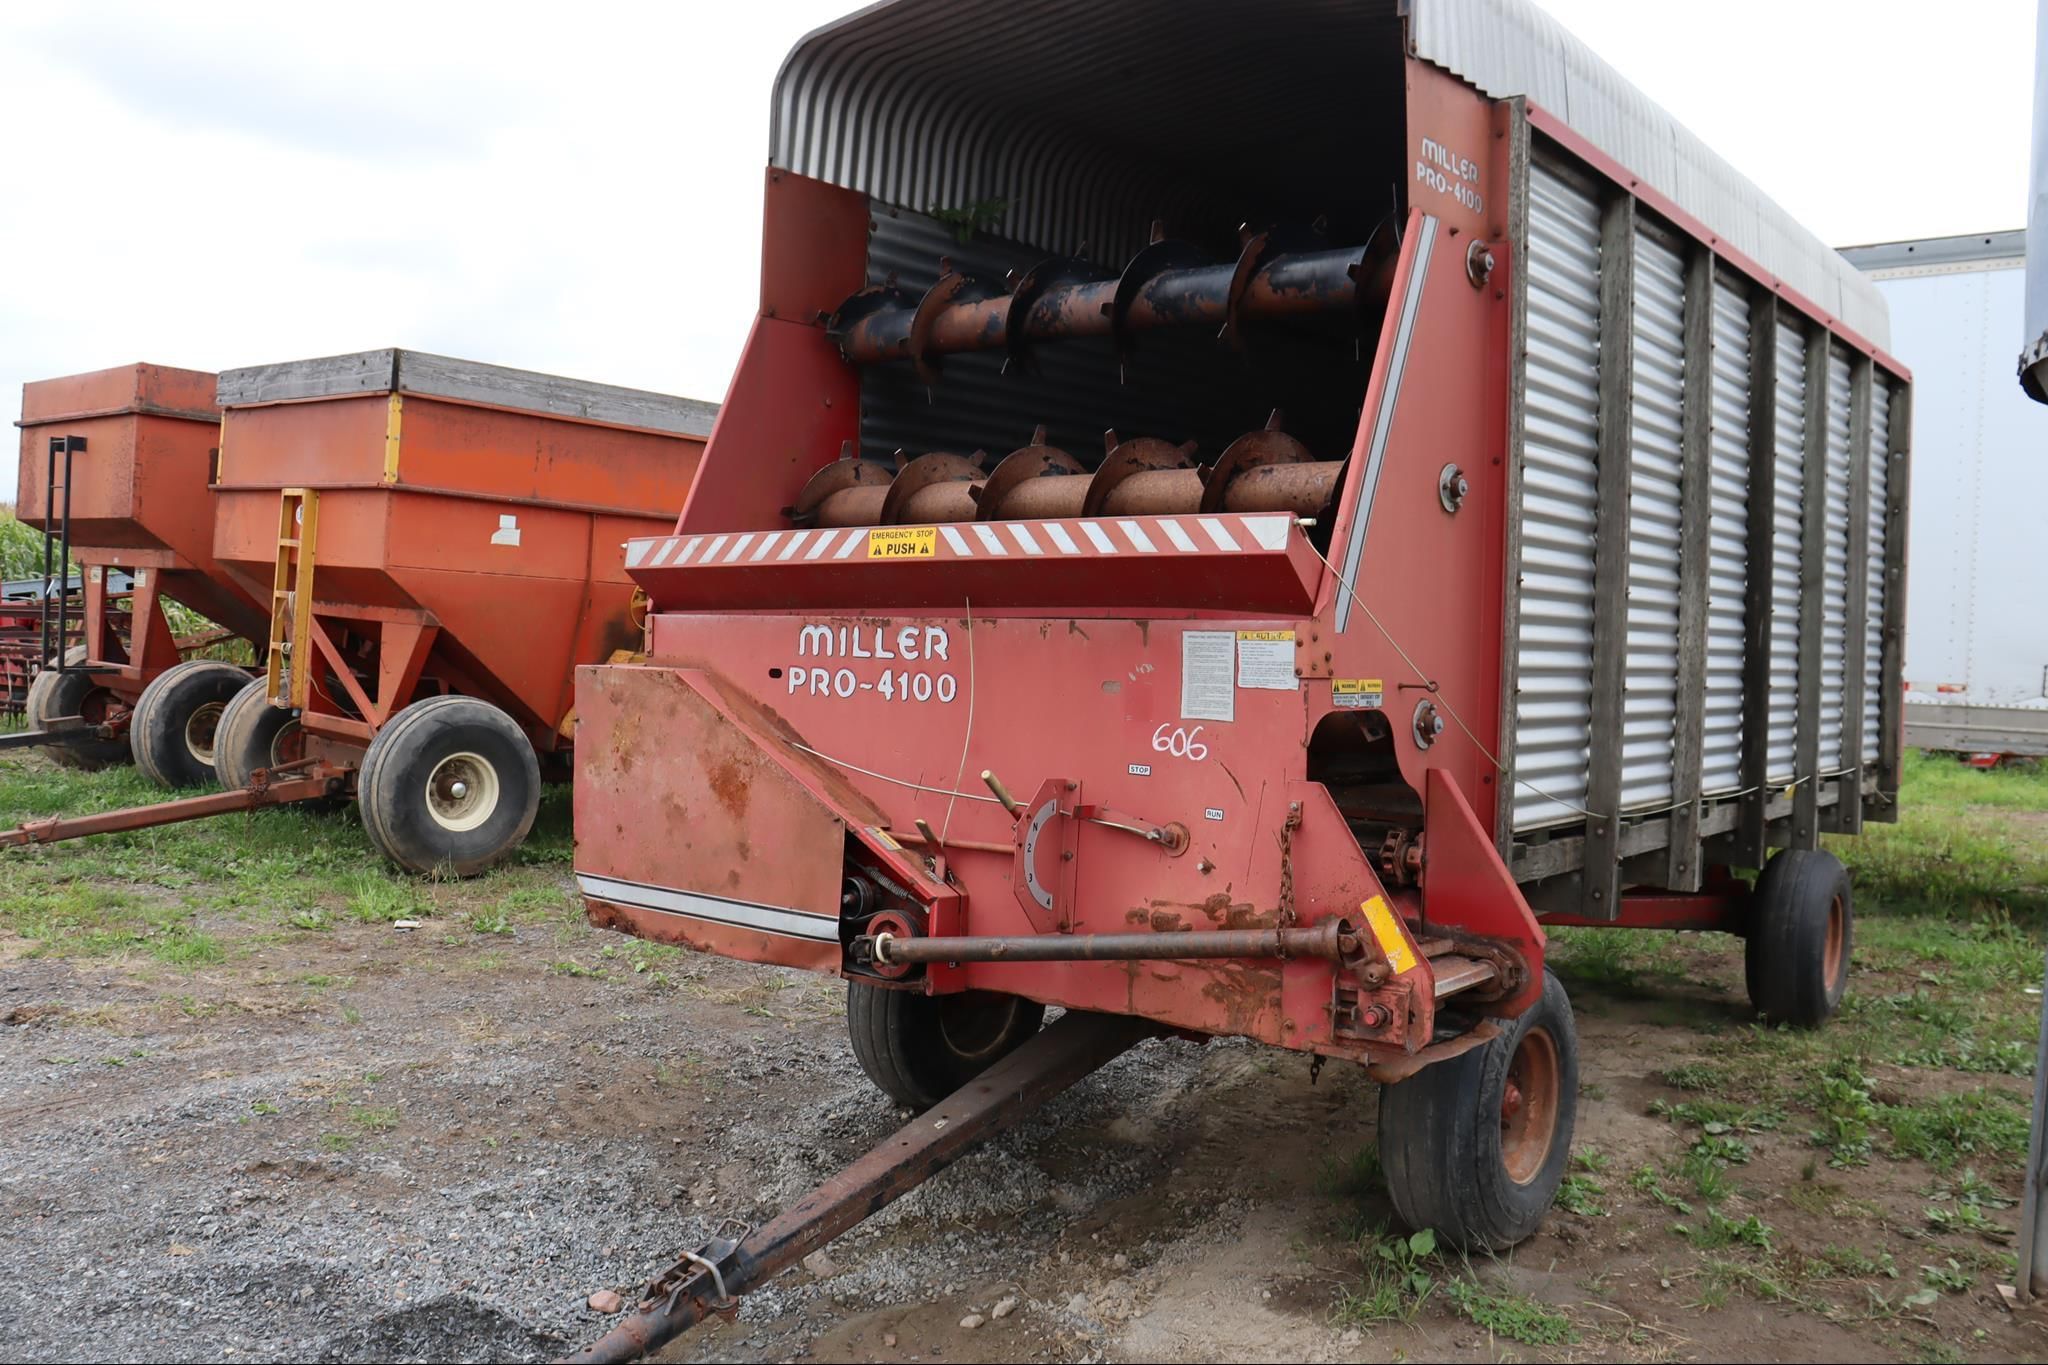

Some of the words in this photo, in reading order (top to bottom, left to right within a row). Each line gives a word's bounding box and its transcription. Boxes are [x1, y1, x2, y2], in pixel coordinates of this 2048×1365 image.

[1422, 138, 1478, 184] MILLER
[1417, 161, 1482, 213] PRO-4100
[872, 531, 913, 540] EMERGENCY
[916, 529, 934, 538] STOP
[886, 543, 916, 555] PUSH
[799, 624, 949, 661] MILLER
[788, 666, 957, 703] PRO-4100
[1152, 722, 1208, 761] 606
[1130, 766, 1149, 774] STOP
[1207, 810, 1222, 819] RUN
[1032, 822, 1038, 832] N
[1027, 843, 1032, 853] 2
[1028, 873, 1033, 883] 3
